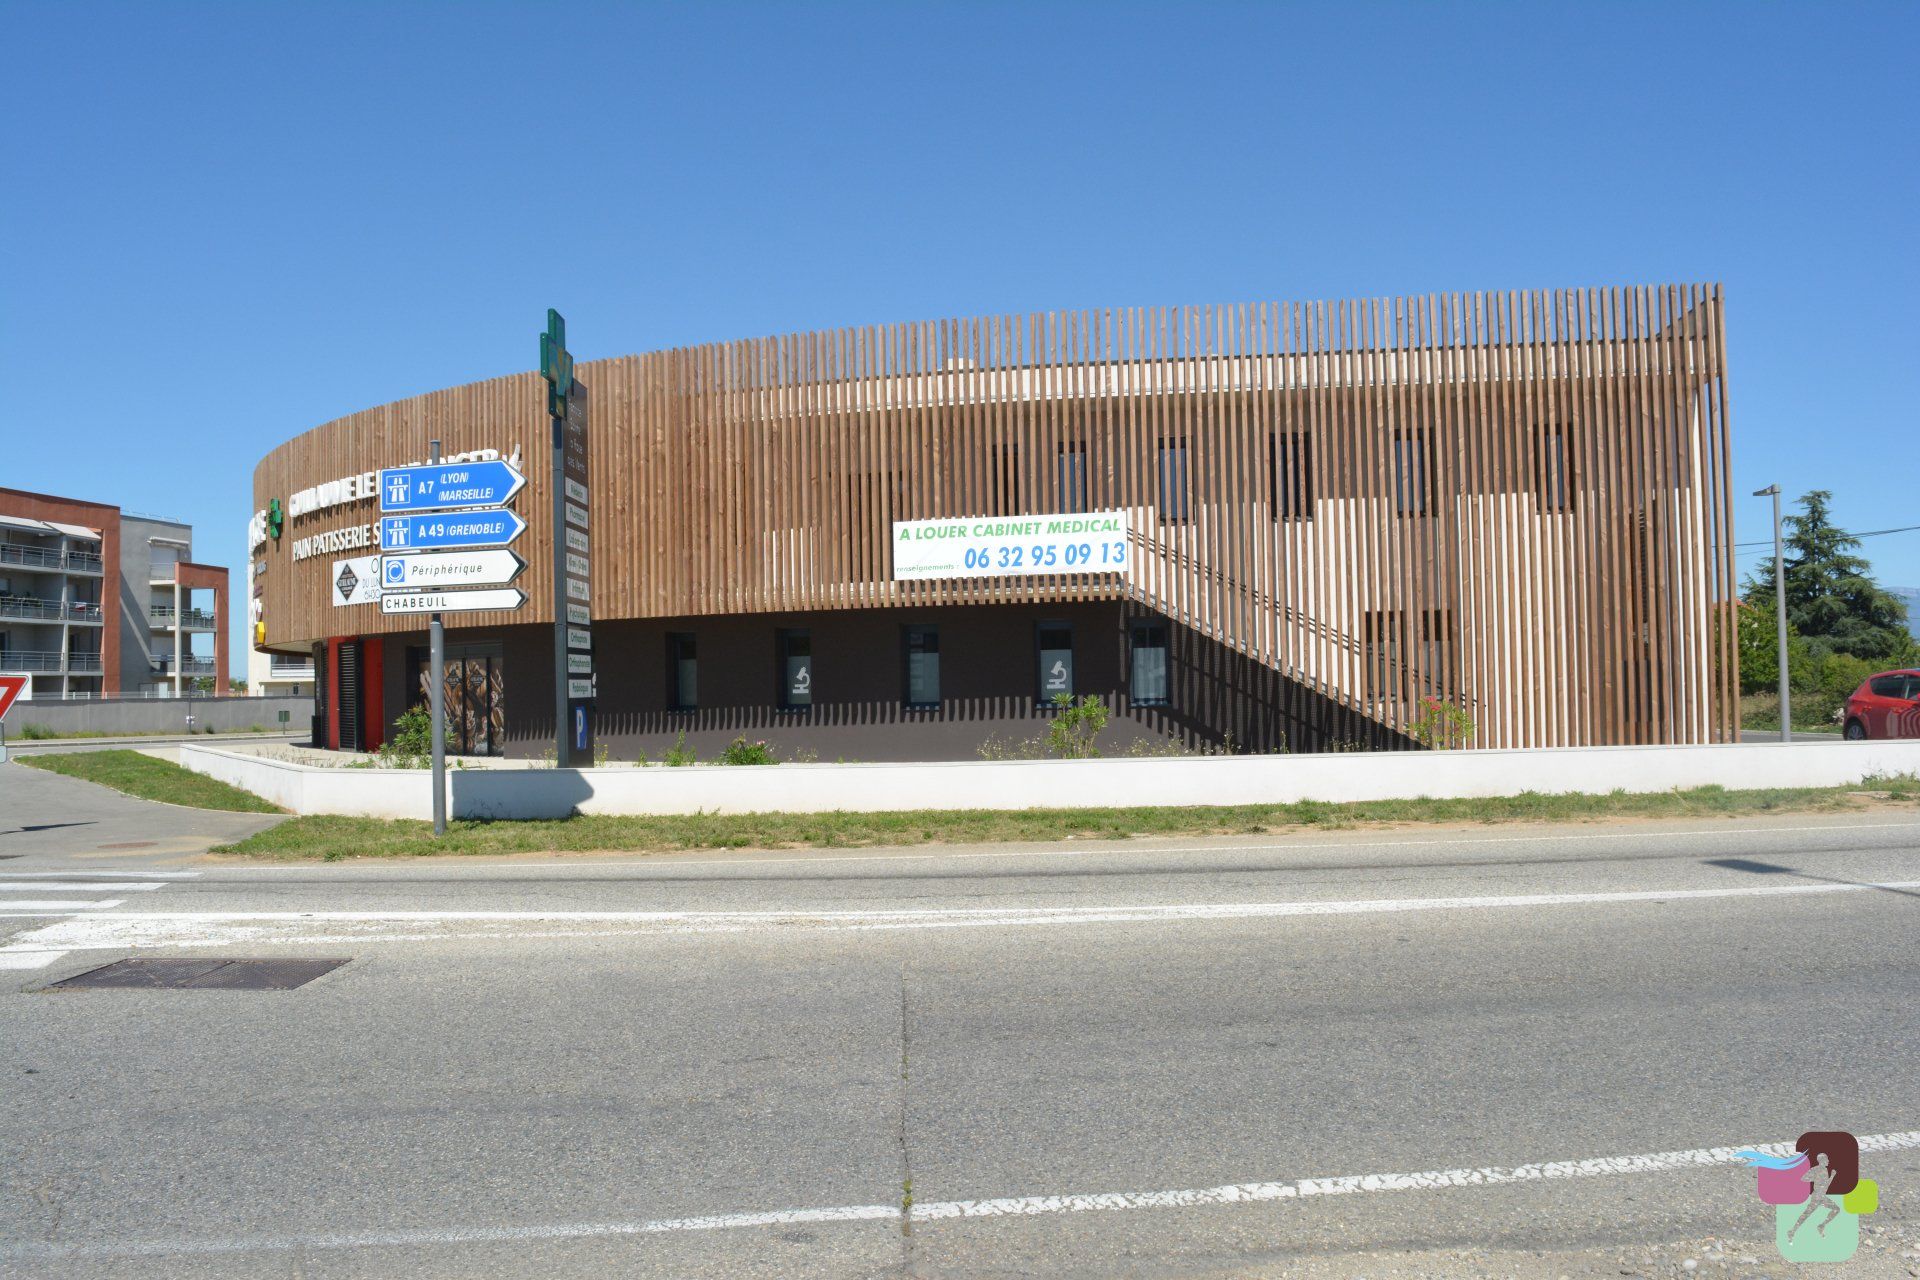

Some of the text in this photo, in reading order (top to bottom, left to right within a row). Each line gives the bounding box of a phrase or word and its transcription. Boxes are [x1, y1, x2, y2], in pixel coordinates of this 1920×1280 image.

[440, 472, 469, 484] (LYON)
[438, 487, 494, 501] (MARSEILLE)
[446, 522, 505, 537] (GRENOBLE)
[899, 519, 1121, 541] A LOUER CABINET MEDICAL
[293, 537, 312, 561] PAIN
[313, 524, 371, 555] PATISSERIE
[964, 542, 1126, 569] 06 32 95 09 13
[412, 563, 483, 577] Périphérique
[386, 596, 447, 609] CHABEUIL
